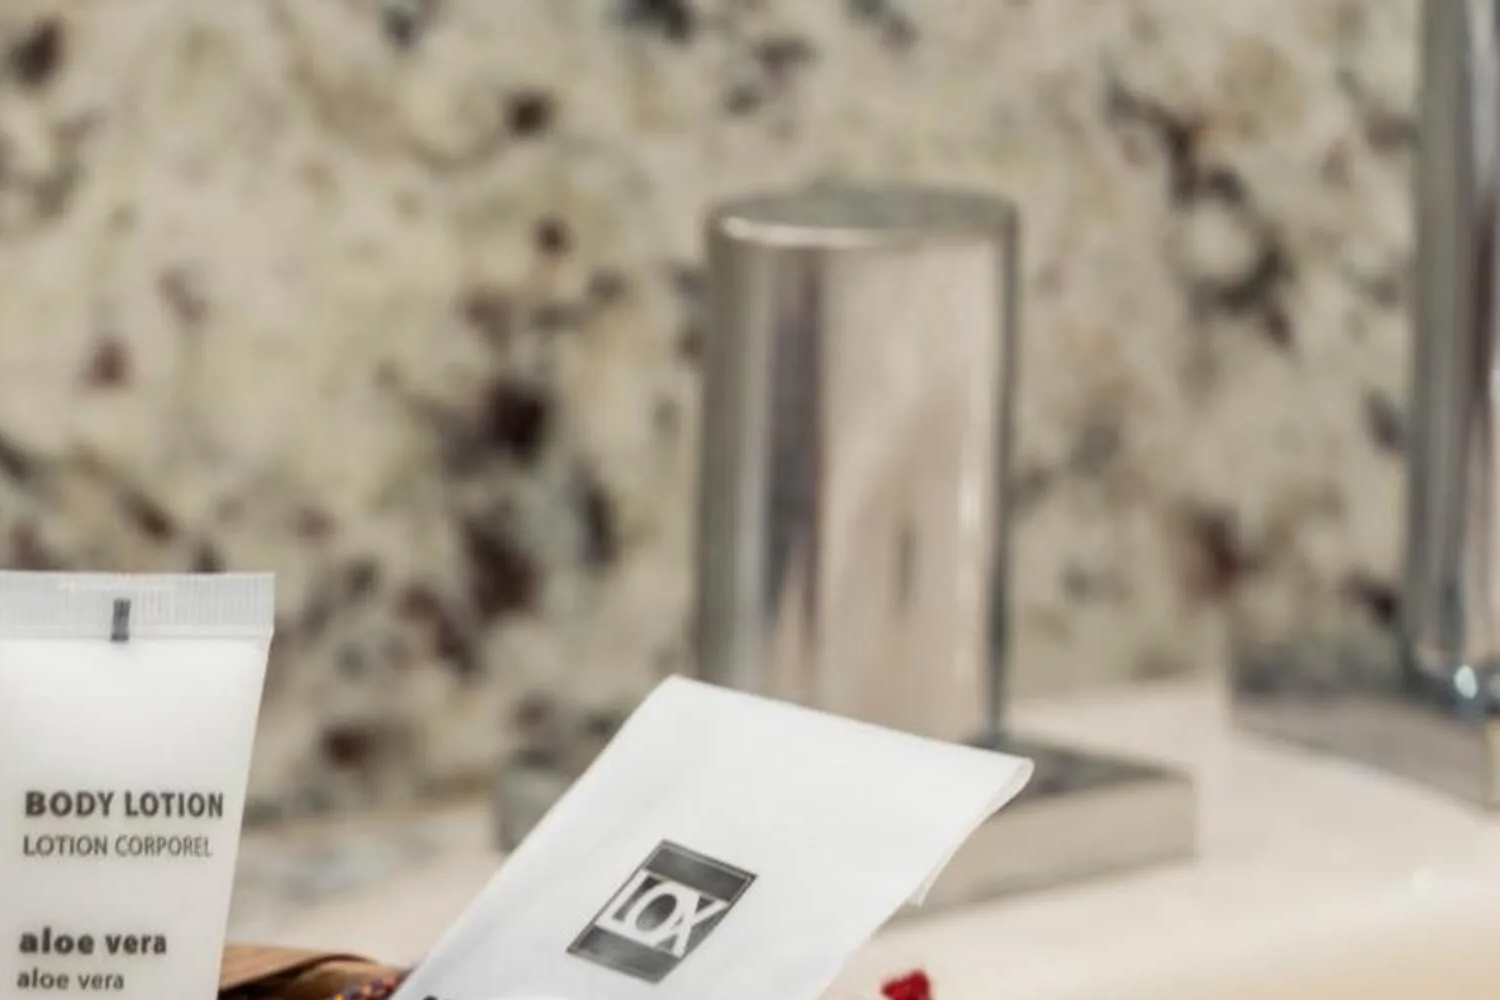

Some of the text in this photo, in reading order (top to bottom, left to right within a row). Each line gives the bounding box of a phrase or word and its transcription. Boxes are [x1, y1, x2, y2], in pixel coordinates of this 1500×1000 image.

[24, 790, 224, 818] BODY LOTION
[23, 834, 212, 858] LOTION CORPOREL
[594, 868, 728, 959] LOX
[18, 927, 168, 955] aloe vera
[16, 969, 125, 991] aloe vera
